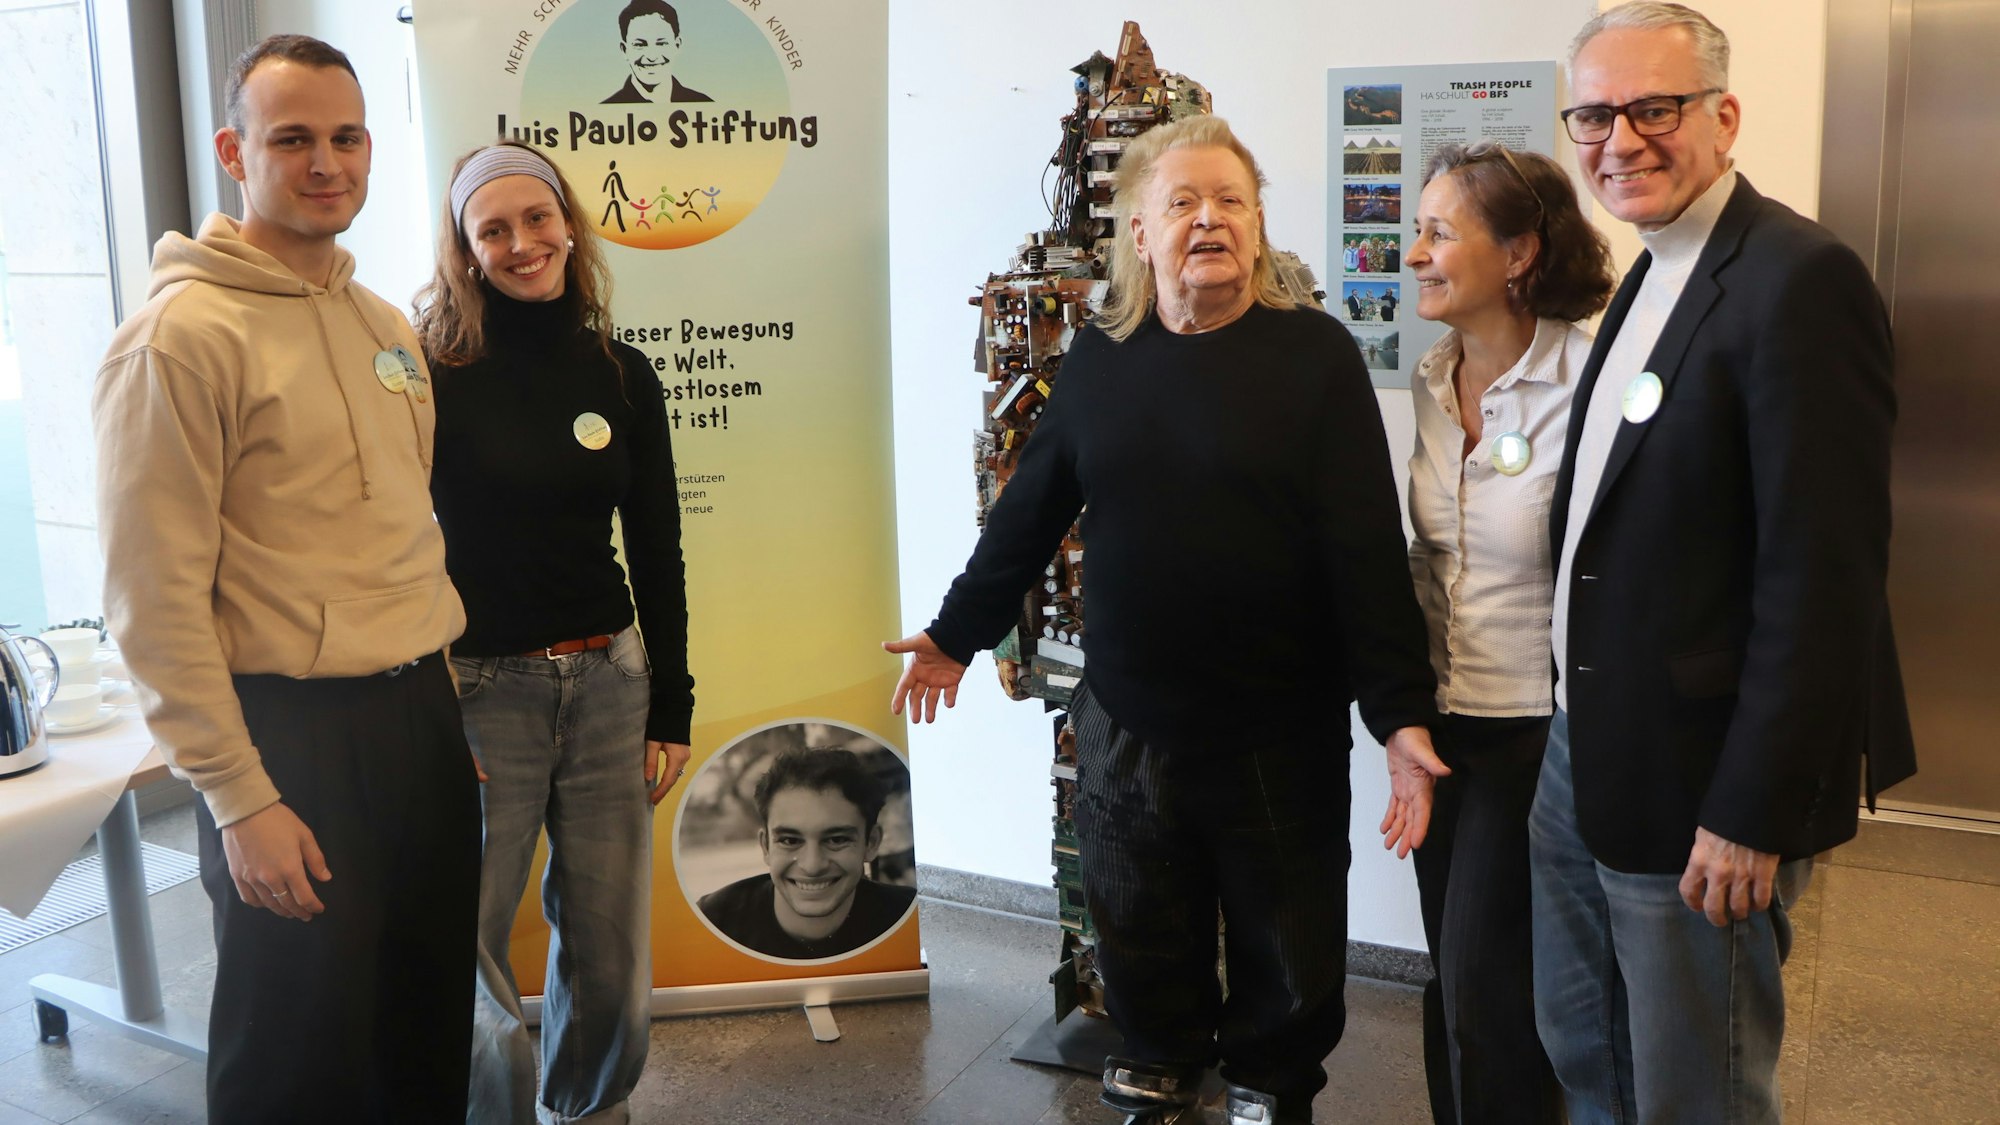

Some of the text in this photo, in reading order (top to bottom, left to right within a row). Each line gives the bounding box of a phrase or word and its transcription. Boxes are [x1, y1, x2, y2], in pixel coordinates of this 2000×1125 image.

[504, 30, 533, 75] MEHR
[766, 16, 803, 71] KINDER
[1420, 90, 1508, 100] HA SCHULT GO BFS
[1450, 80, 1532, 90] TRASH PEOPLE
[569, 111, 658, 151] Paulo
[668, 109, 818, 148] Stiftung
[611, 318, 793, 344] ieser Bewegung
[674, 347, 735, 374] Welt,
[690, 405, 728, 430] ist!
[685, 505, 714, 515] neue
